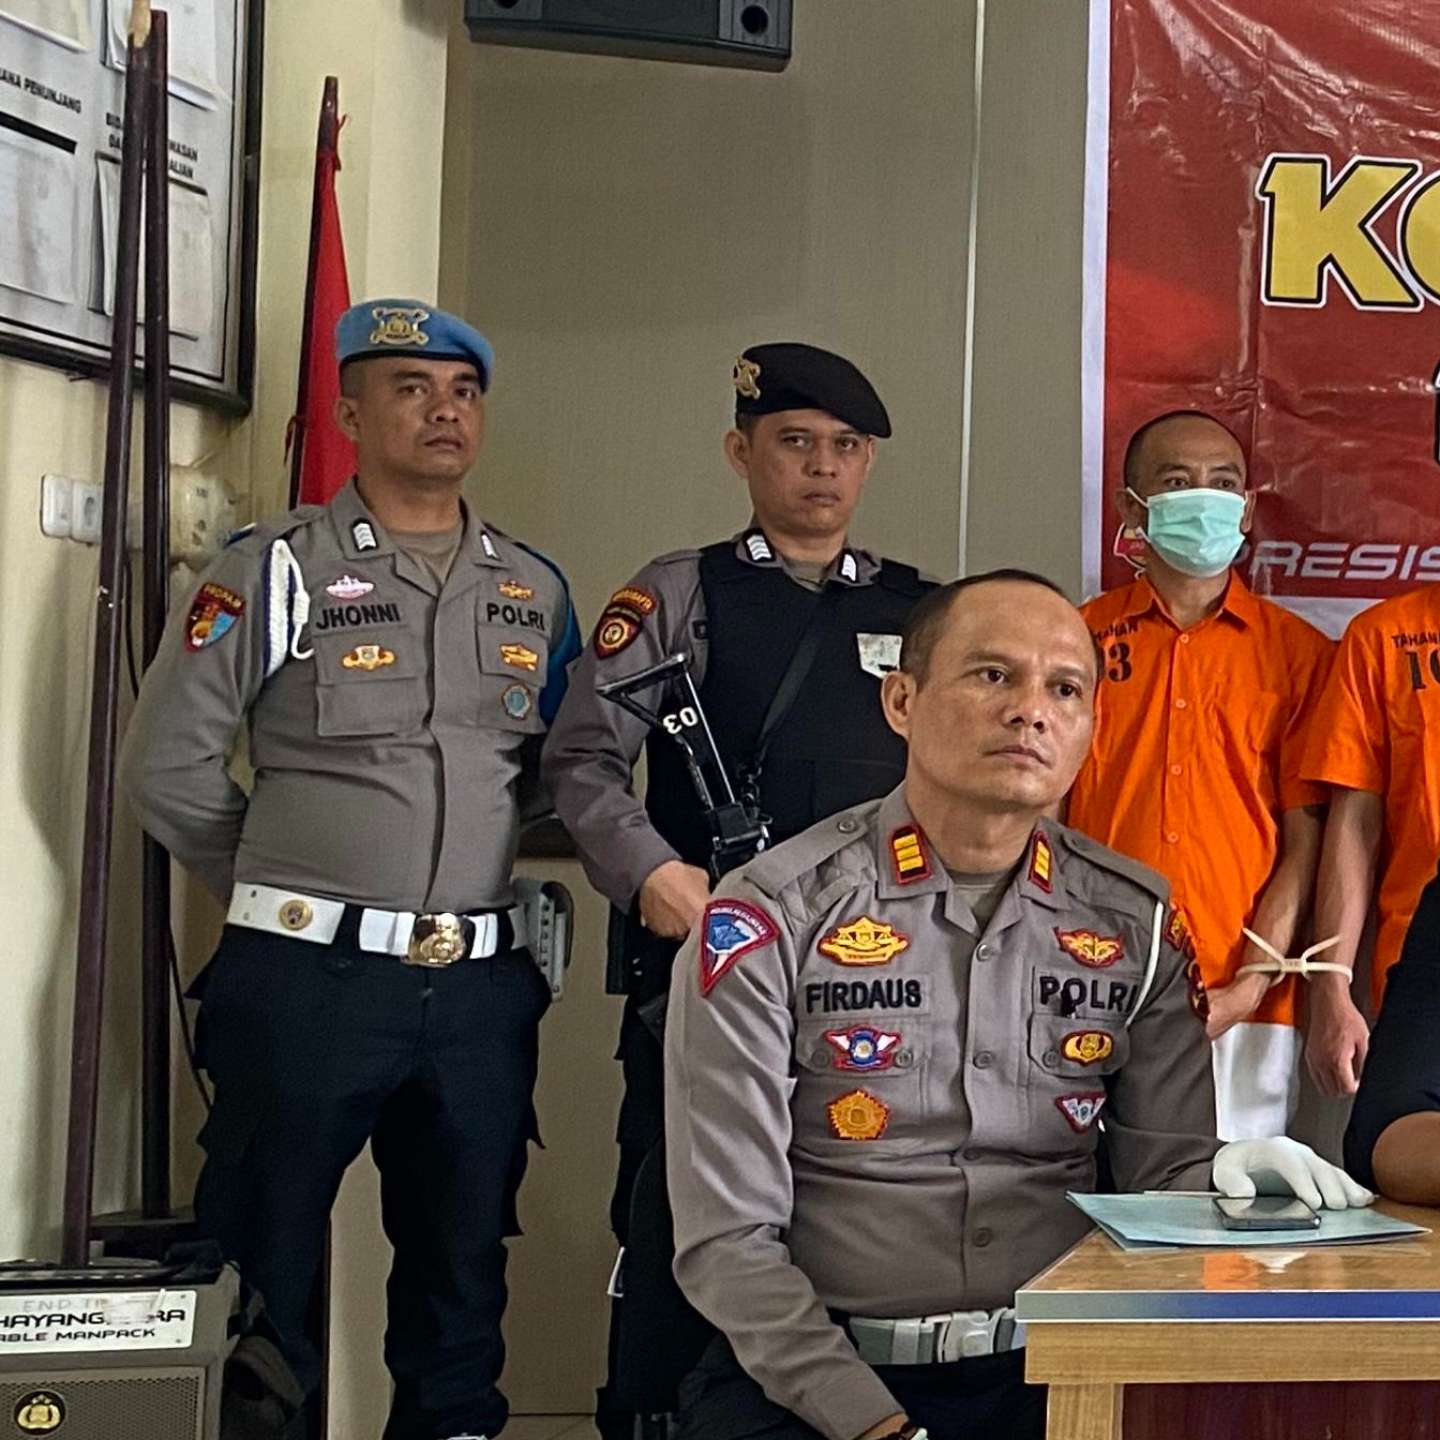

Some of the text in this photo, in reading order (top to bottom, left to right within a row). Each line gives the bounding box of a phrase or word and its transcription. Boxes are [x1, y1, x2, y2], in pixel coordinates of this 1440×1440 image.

[316, 603, 401, 630] JHONNI
[486, 603, 545, 631] POLRI
[663, 706, 698, 734] 03
[805, 979, 922, 1011] FIRDAUS
[1040, 976, 1138, 1010] POLRI
[55, 1328, 156, 1342] MANPACK
